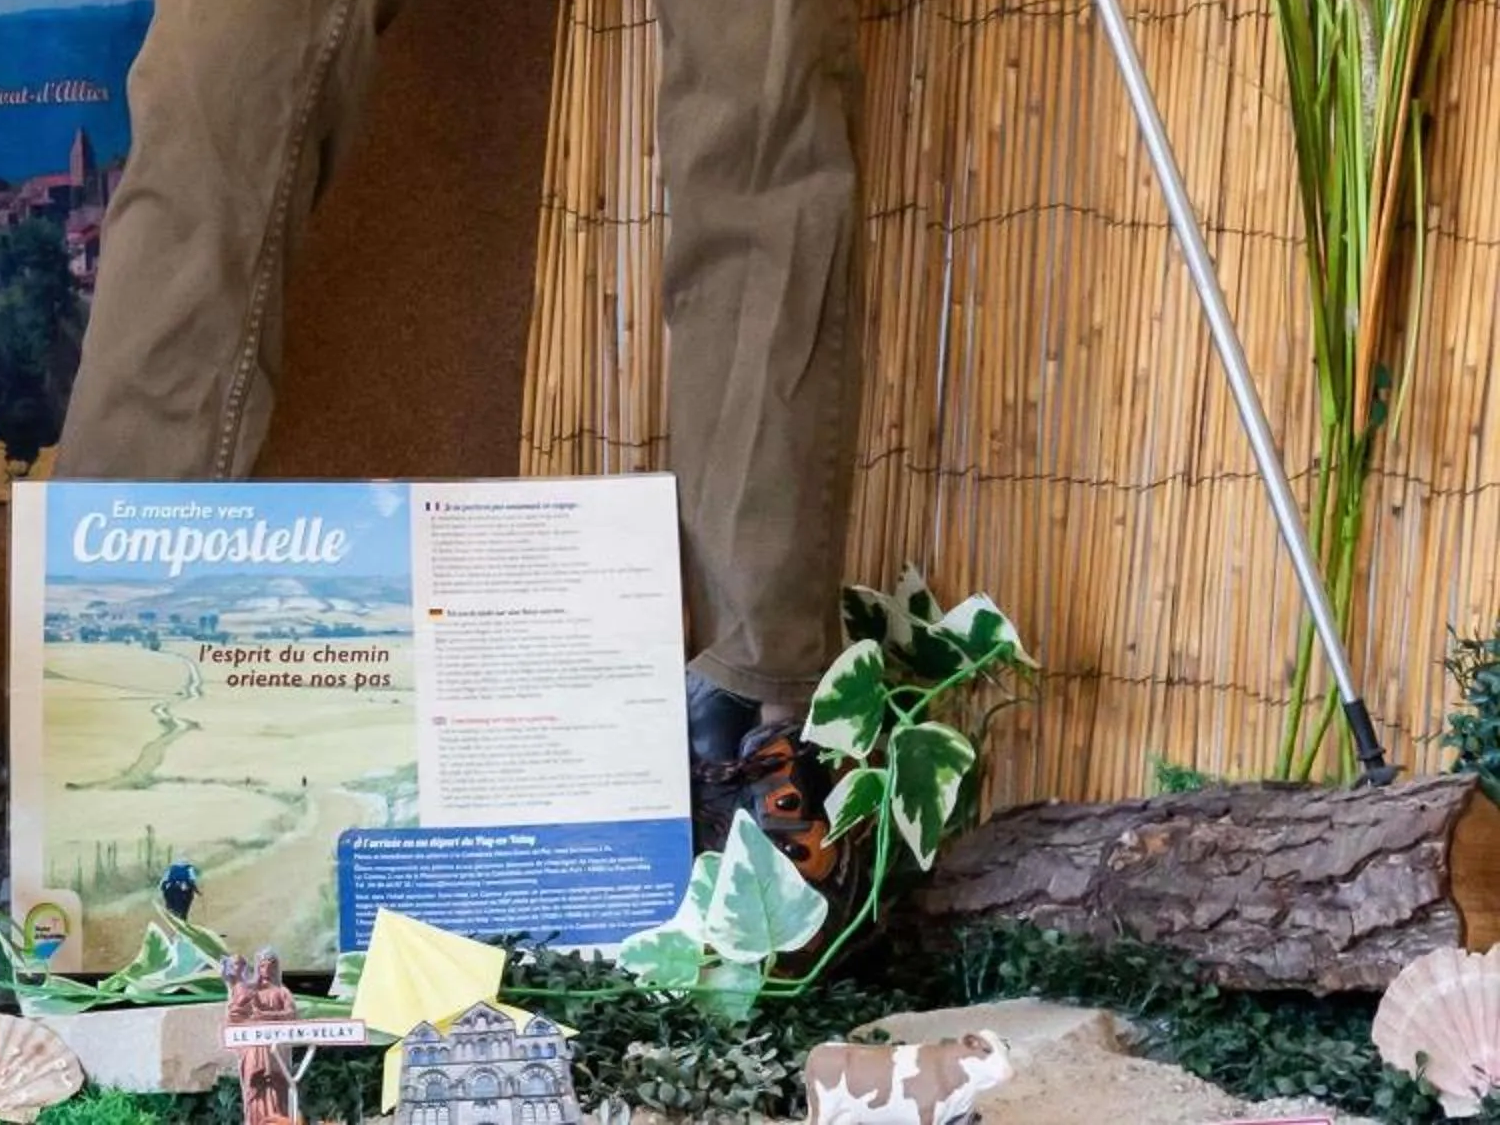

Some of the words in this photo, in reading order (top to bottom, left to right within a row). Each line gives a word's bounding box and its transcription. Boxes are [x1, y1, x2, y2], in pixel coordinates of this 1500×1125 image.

[113, 501, 138, 519] En
[142, 500, 213, 519] marche
[217, 504, 255, 519] vers
[73, 512, 351, 577] Compostelle
[199, 644, 271, 665] l'esprit
[279, 644, 306, 663] du
[313, 643, 389, 663] chemin
[227, 670, 303, 688] oriente
[309, 673, 346, 688] nos
[354, 673, 391, 691] pas
[232, 1030, 250, 1042] LE
[255, 1026, 355, 1041] PUY-EN-VELAY
